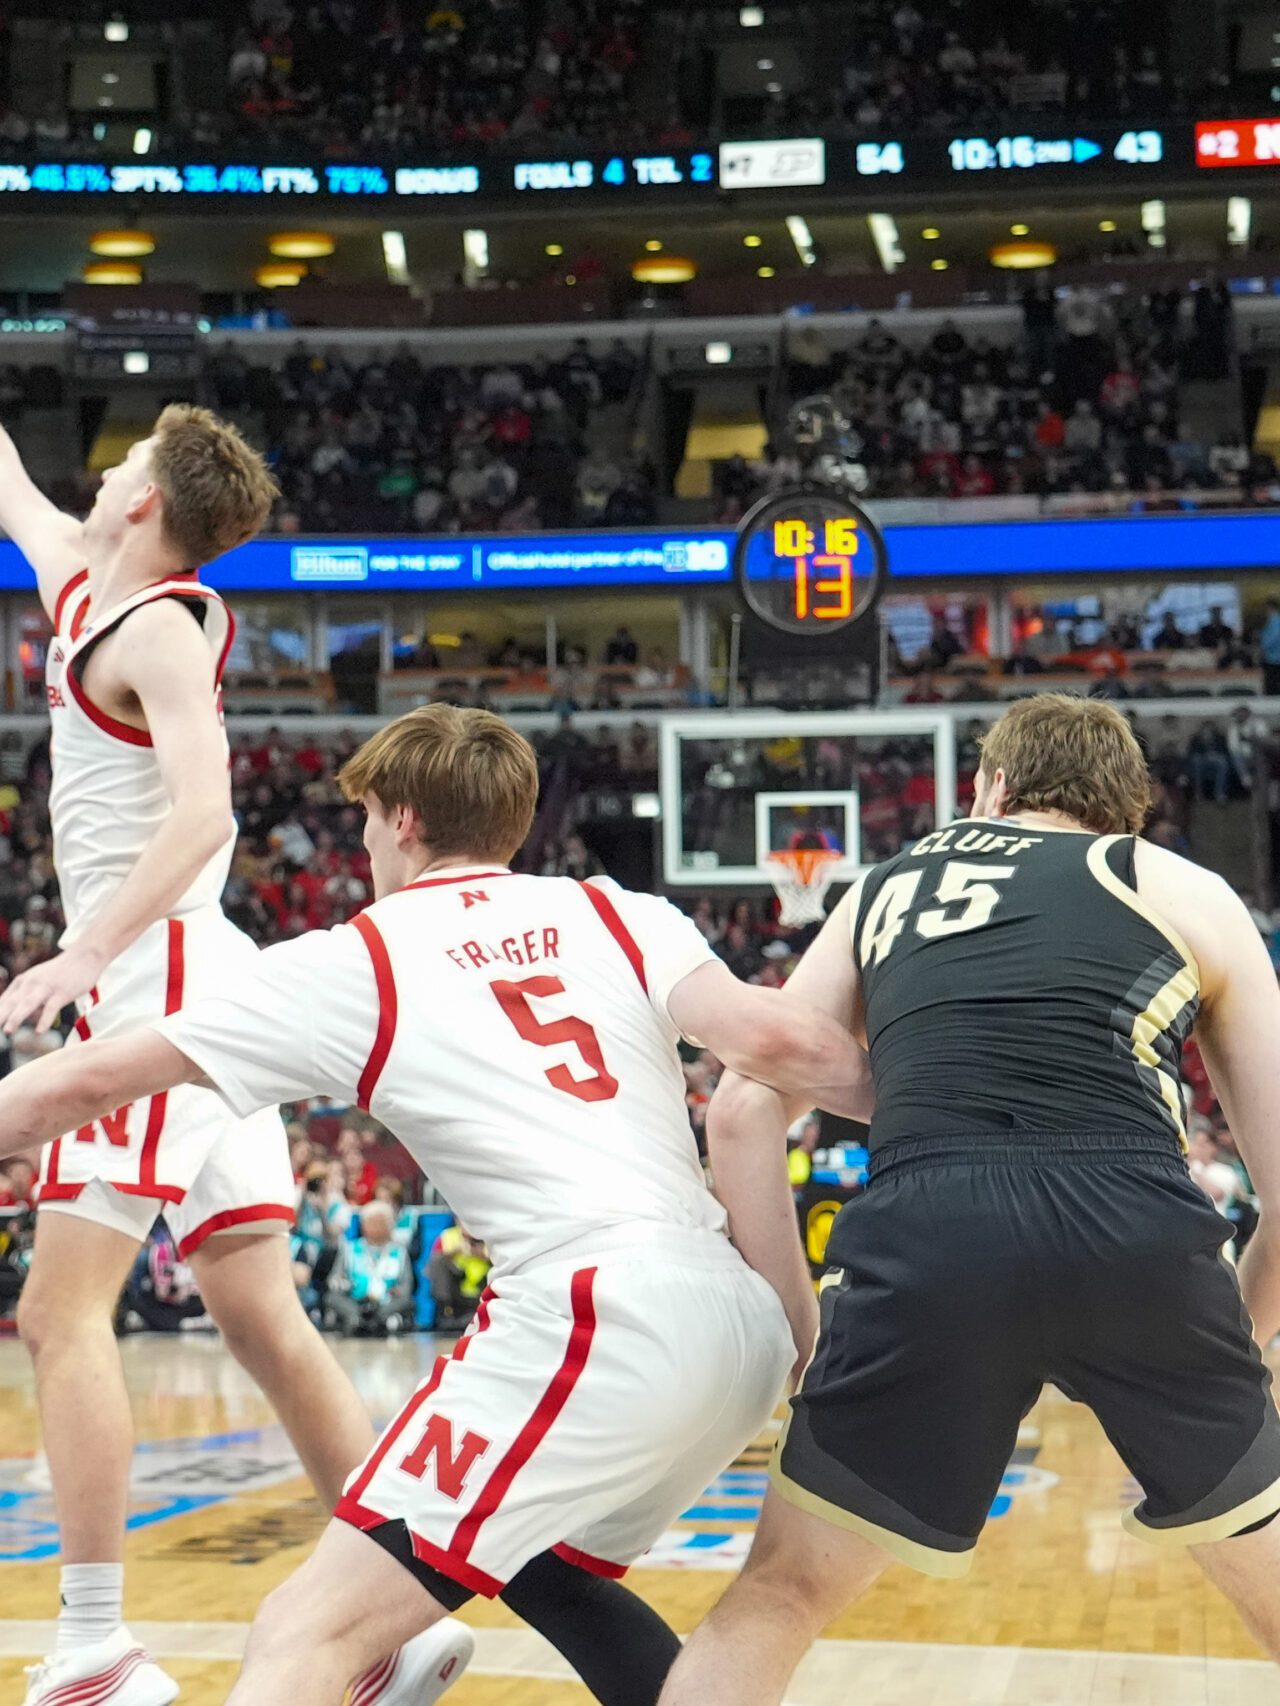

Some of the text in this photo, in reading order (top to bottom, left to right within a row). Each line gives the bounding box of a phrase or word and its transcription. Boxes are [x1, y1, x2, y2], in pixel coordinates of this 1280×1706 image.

[948, 136, 1035, 170] 10:16
[1113, 131, 1163, 163] 43
[261, 167, 319, 193] FT%
[514, 161, 593, 190] FOULS
[602, 157, 625, 185] 4
[690, 153, 713, 182] 2
[774, 518, 858, 557] 10:16
[796, 556, 852, 619] 13
[910, 829, 1043, 856] CLUFF
[459, 890, 490, 909] N
[859, 861, 1017, 970] 45
[489, 975, 619, 1102] 5
[398, 1412, 491, 1502] N
